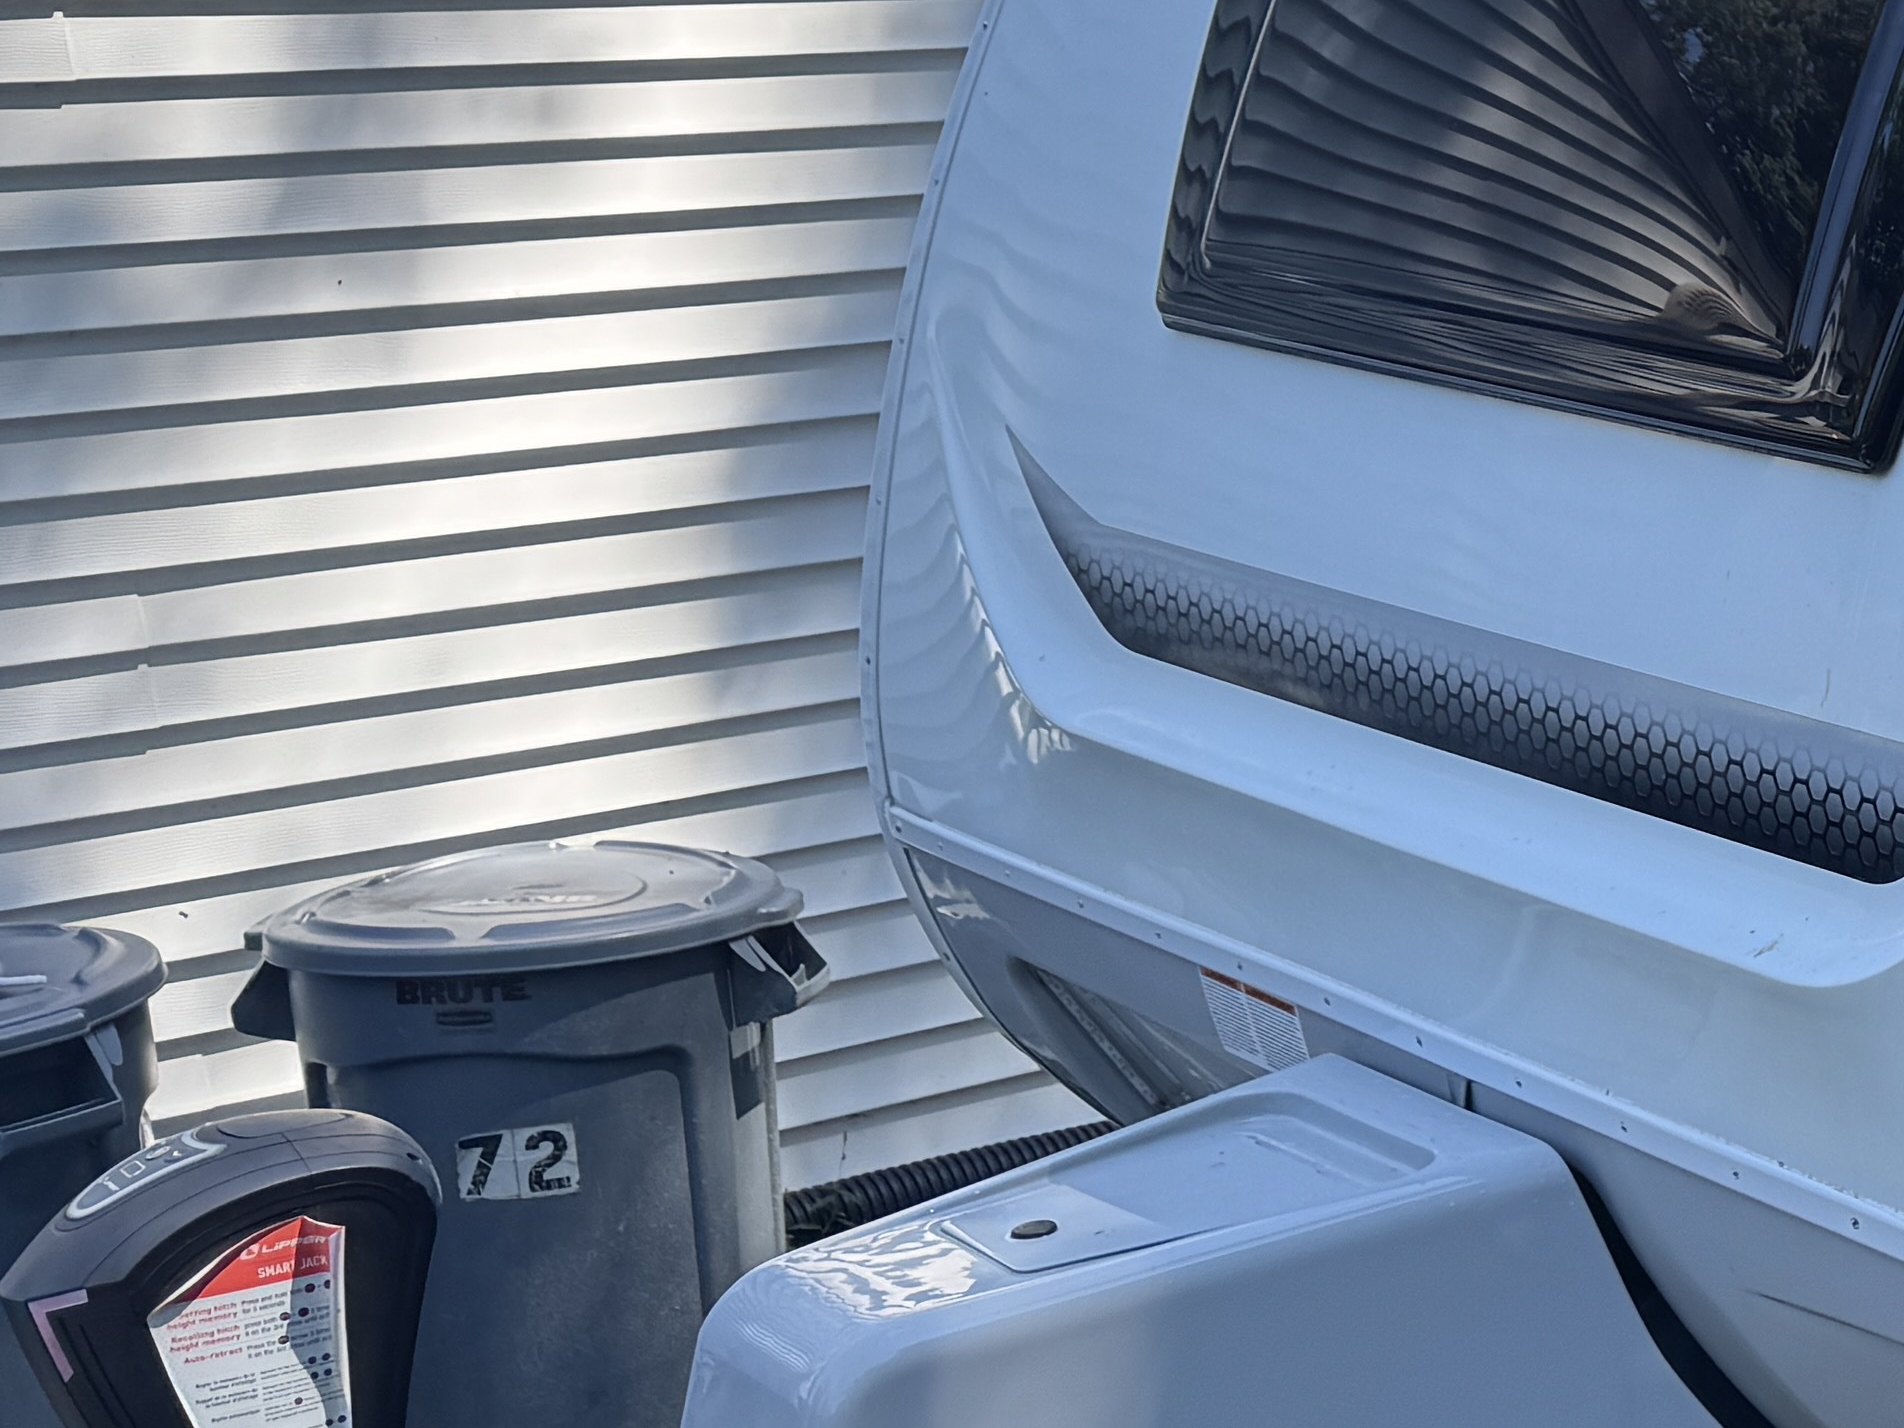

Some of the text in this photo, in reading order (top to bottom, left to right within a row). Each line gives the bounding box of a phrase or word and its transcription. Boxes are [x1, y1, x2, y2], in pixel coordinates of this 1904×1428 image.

[396, 975, 533, 1006] BRUTE
[458, 1130, 571, 1197] 72
[258, 1254, 329, 1279] SMART JACK
